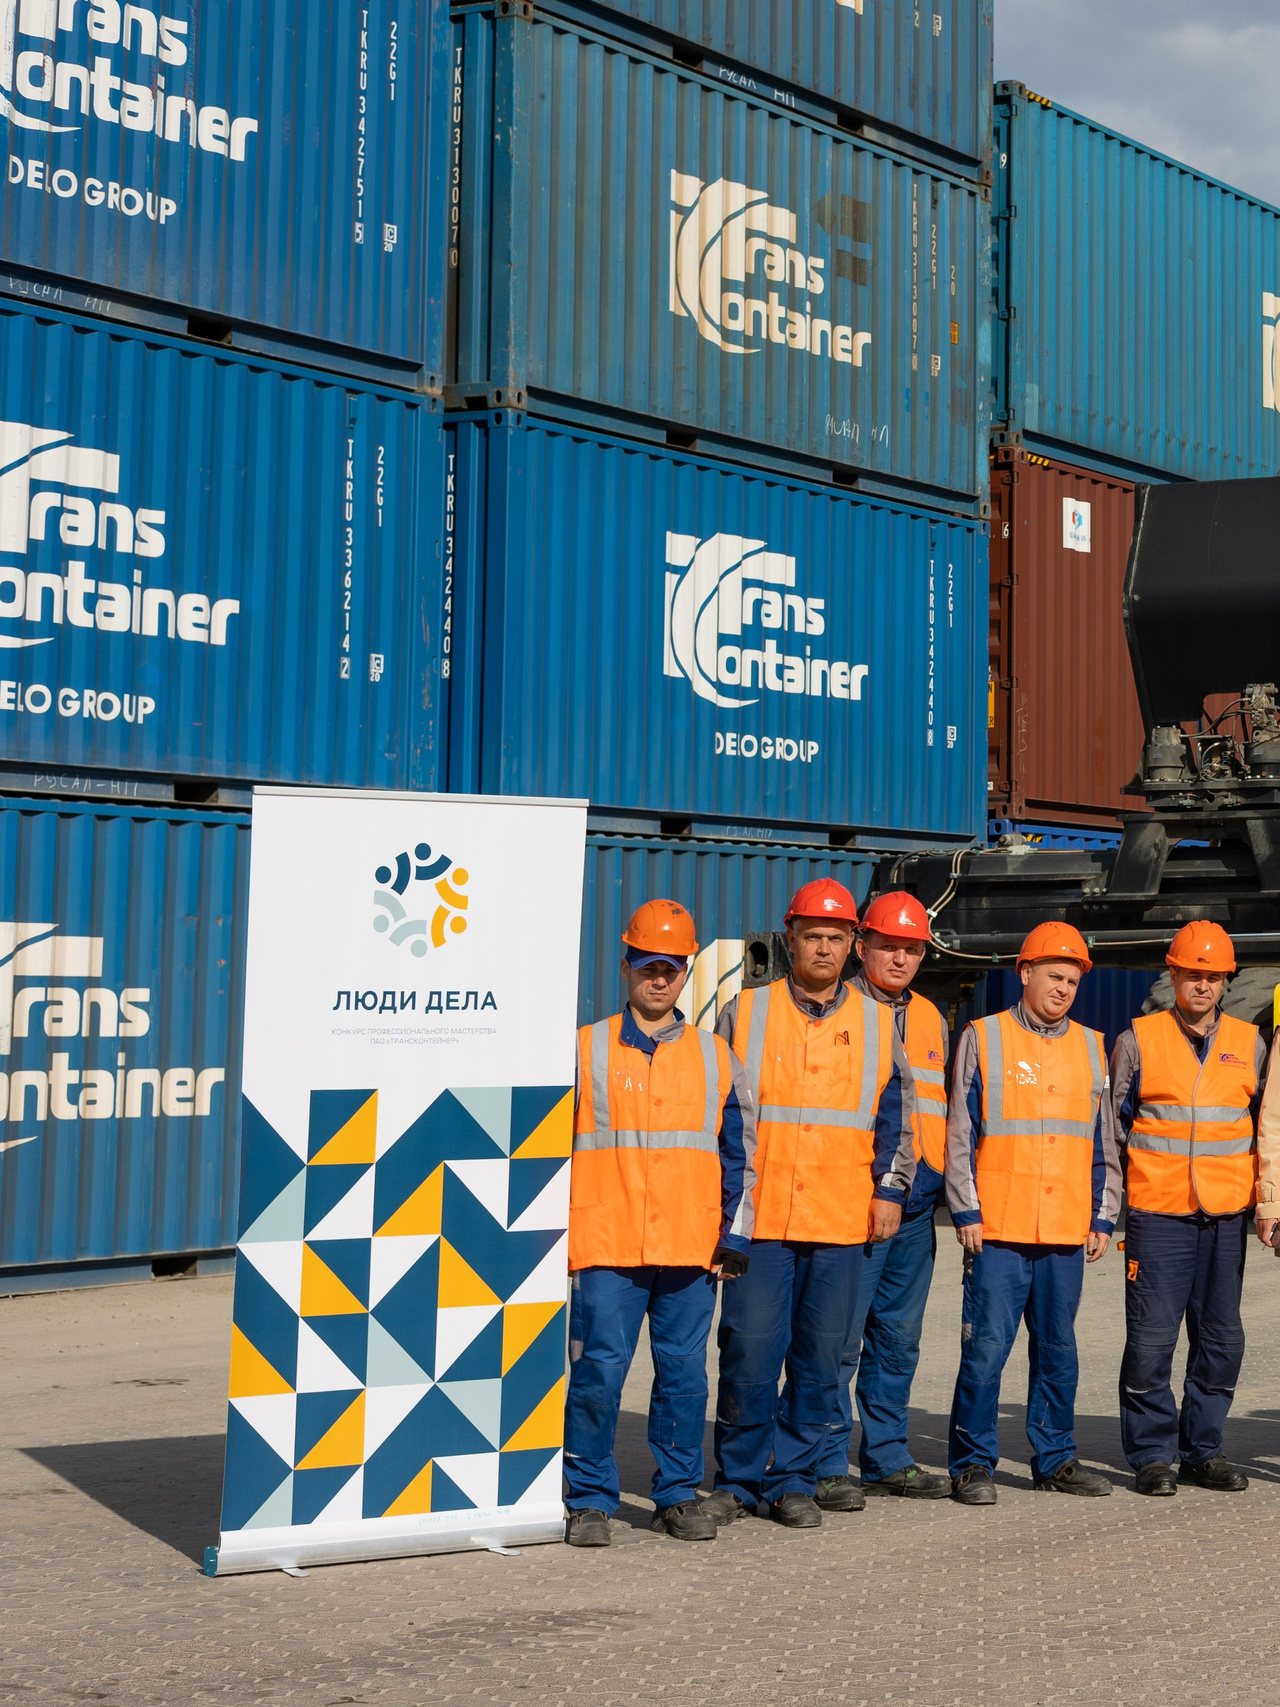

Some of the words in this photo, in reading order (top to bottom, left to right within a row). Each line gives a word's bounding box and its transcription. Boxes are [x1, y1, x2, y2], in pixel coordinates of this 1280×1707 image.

[8, 154, 78, 198] DELO
[84, 177, 177, 225] GROUP
[58, 687, 156, 725] GROUP
[715, 731, 759, 758] DELO
[761, 736, 820, 763] GROUP
[333, 990, 417, 1015] ЛЮДИ
[425, 990, 498, 1015] ДЕЛА
[331, 1028, 366, 1036] КОНКУРС
[367, 1027, 450, 1036] ПРОФЕССИОНАЛЬНОГО
[450, 1027, 498, 1036] МАСТЕРСТВА
[370, 1037, 386, 1046] ПАО
